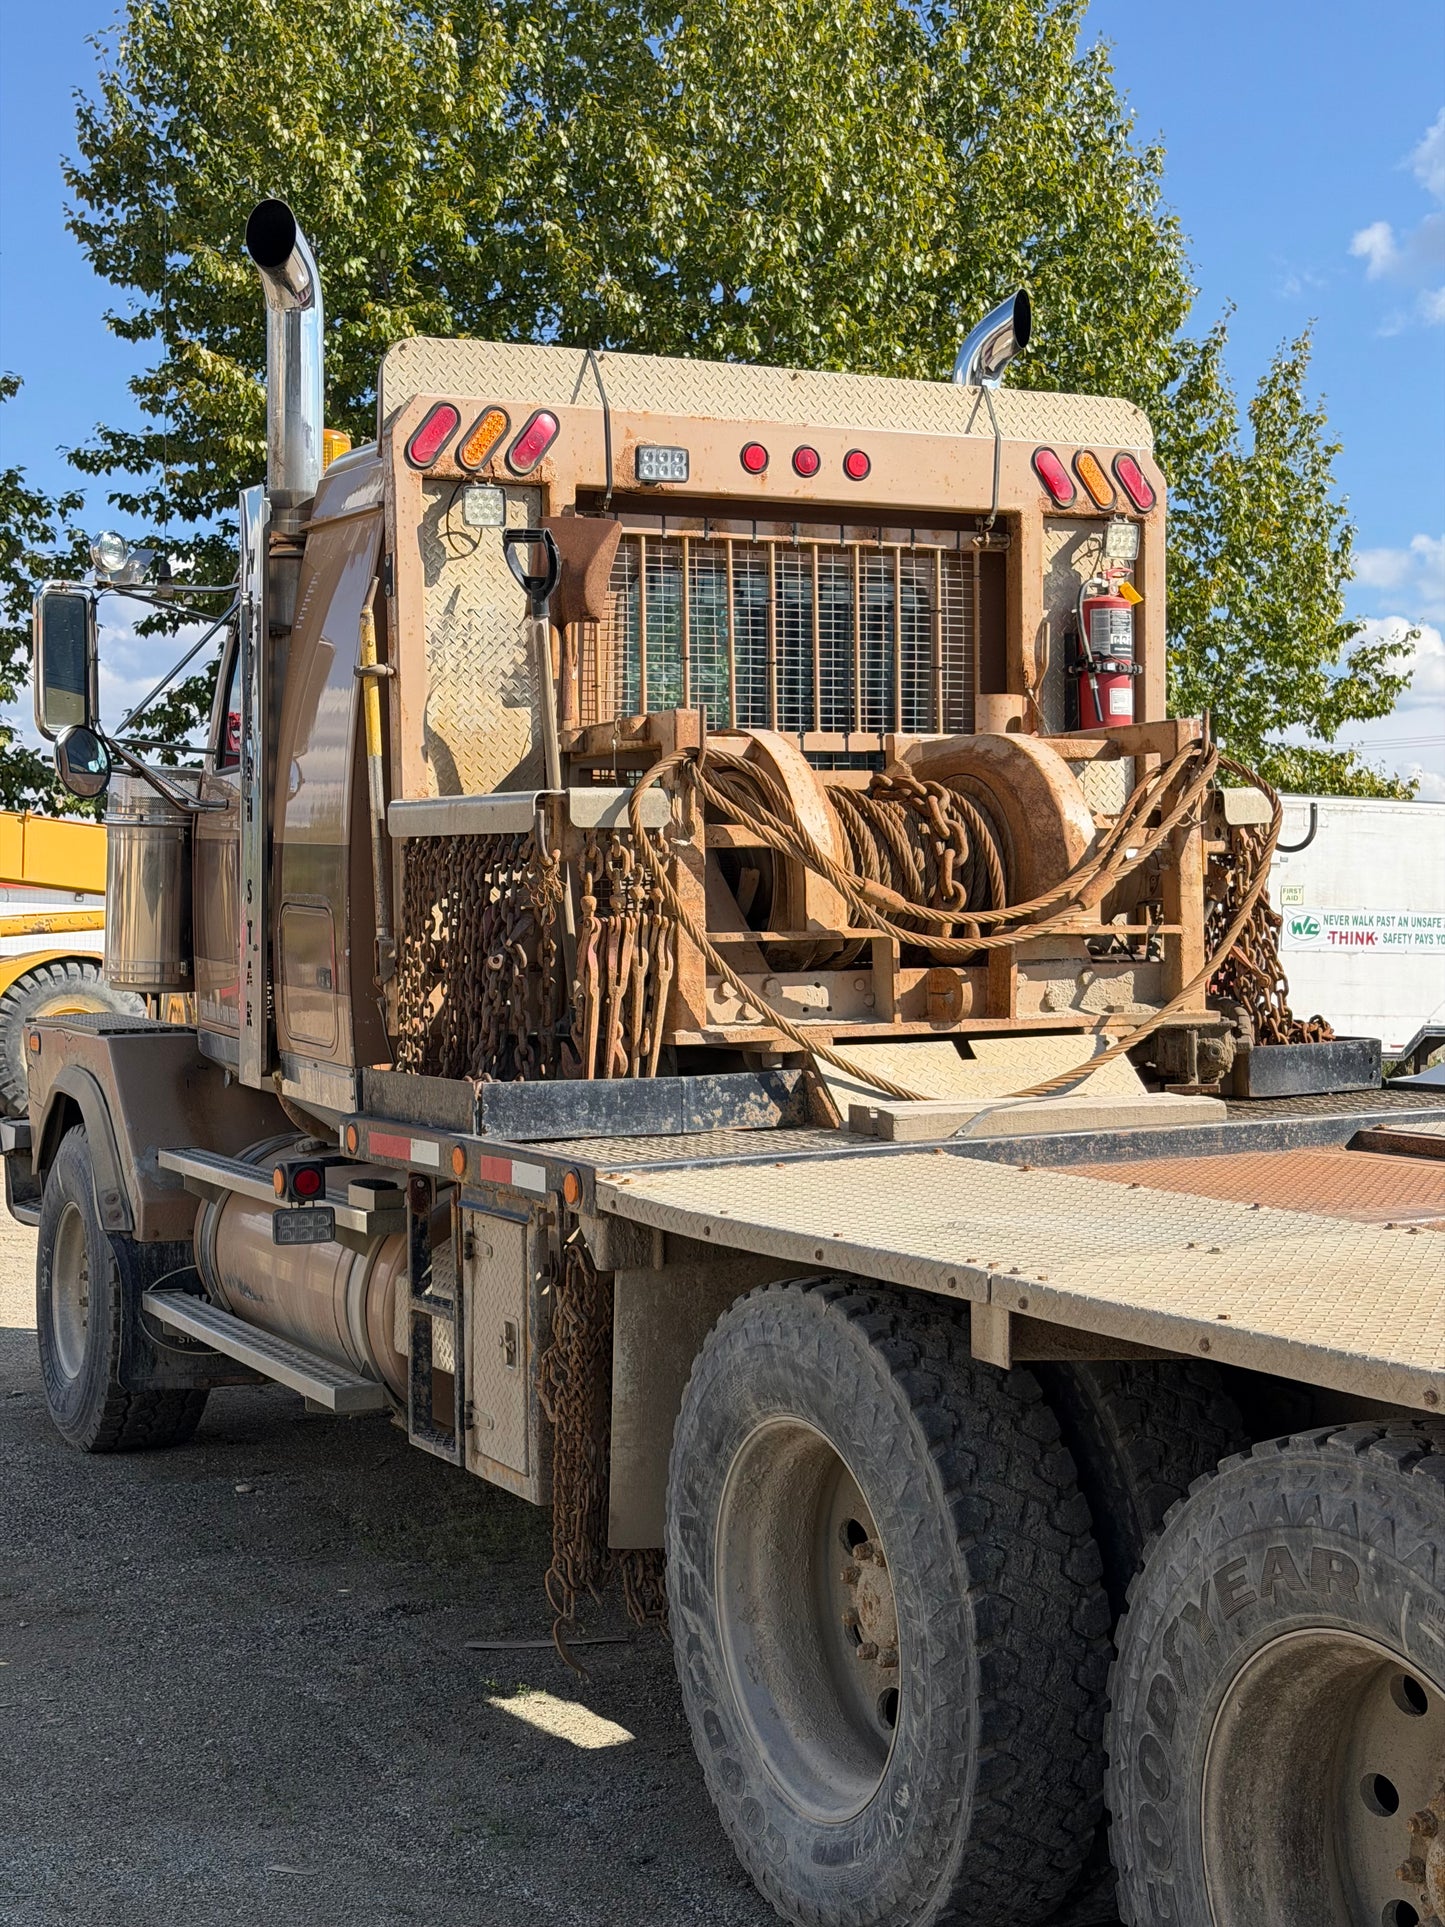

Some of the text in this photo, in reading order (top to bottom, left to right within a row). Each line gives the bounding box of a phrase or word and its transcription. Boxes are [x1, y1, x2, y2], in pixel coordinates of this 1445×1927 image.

[1323, 915, 1350, 926] NEVER
[1352, 916, 1374, 927] WALK
[1376, 916, 1396, 927] PAST
[1398, 916, 1409, 927] AN
[1411, 917, 1442, 928] UNSAFE
[1382, 933, 1413, 944] SAFETY
[1415, 933, 1434, 945] PAYS
